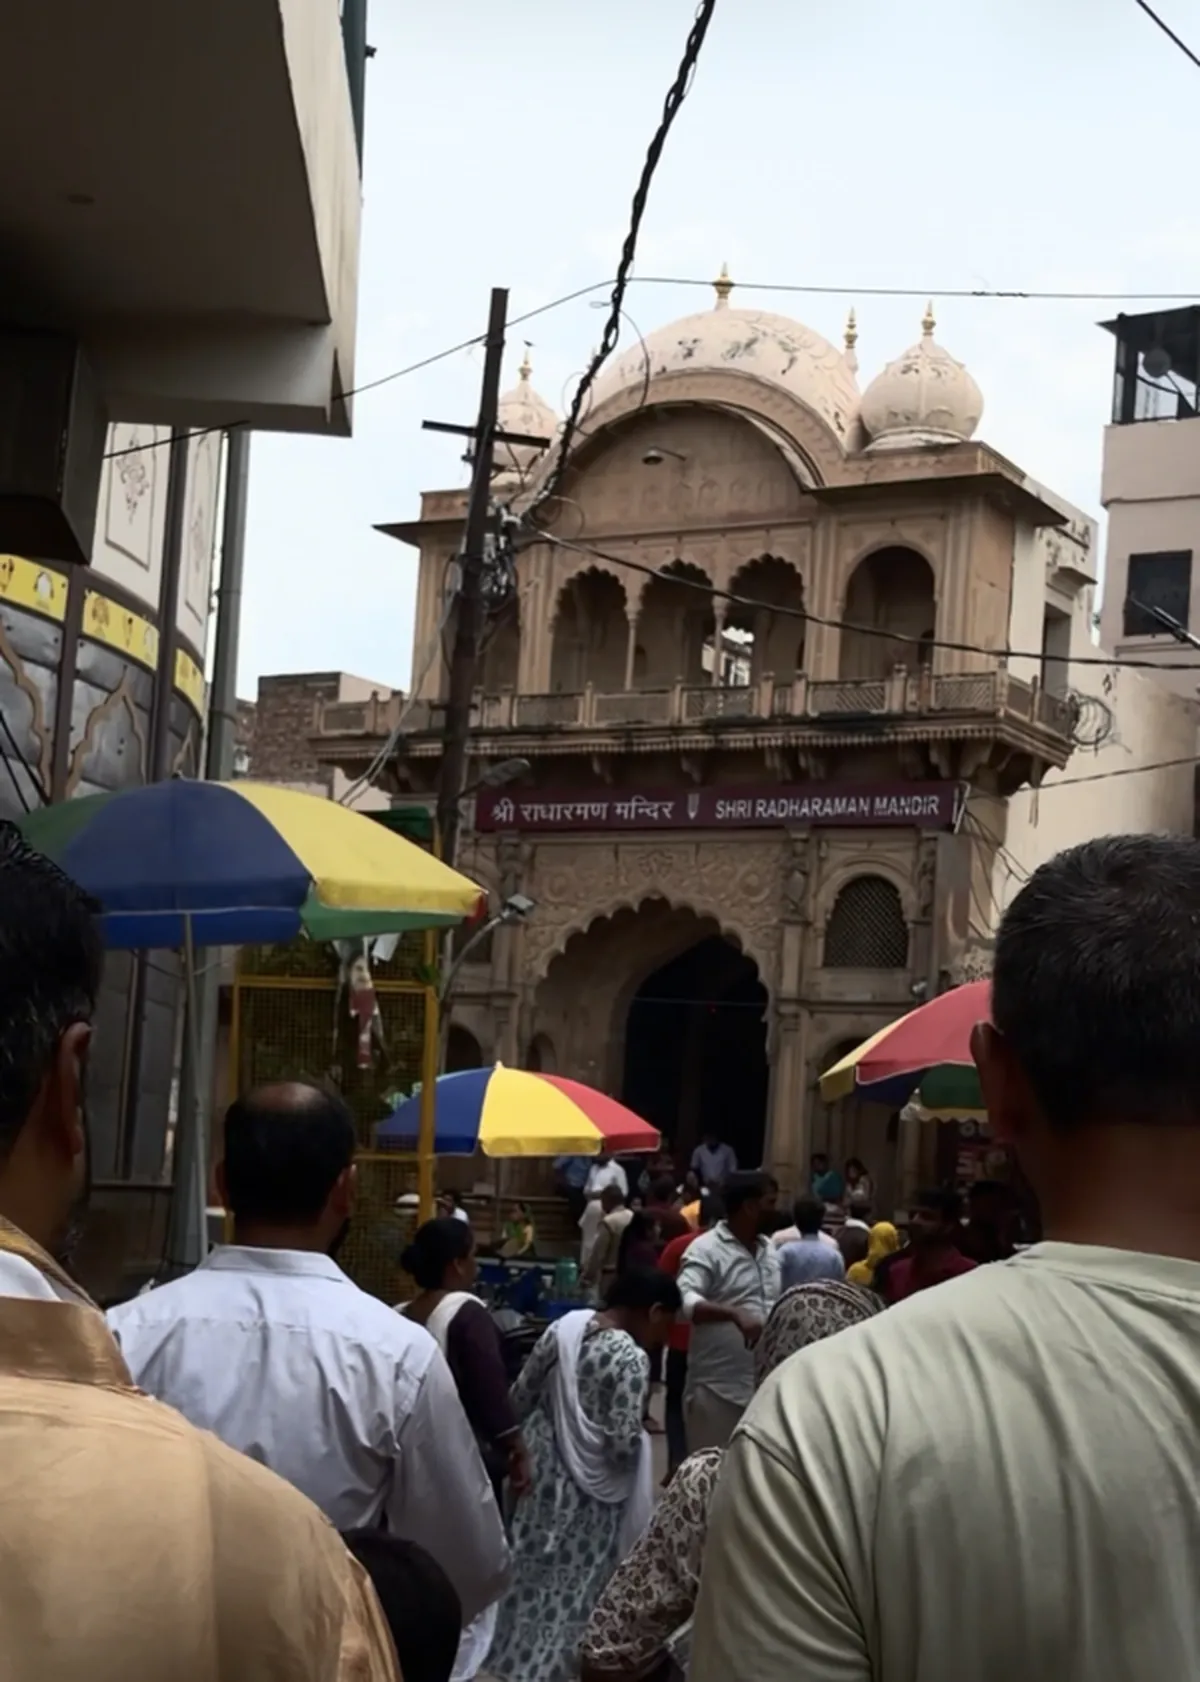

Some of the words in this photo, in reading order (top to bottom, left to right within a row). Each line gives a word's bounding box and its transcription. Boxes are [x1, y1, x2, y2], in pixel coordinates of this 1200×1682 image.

[492, 797, 515, 822] श्री
[520, 802, 608, 821] राधारमण
[613, 795, 675, 820] मन्दिर
[715, 799, 751, 819] SHRI
[755, 797, 870, 818] RADHARAMAN
[874, 795, 940, 816] MANDIR
